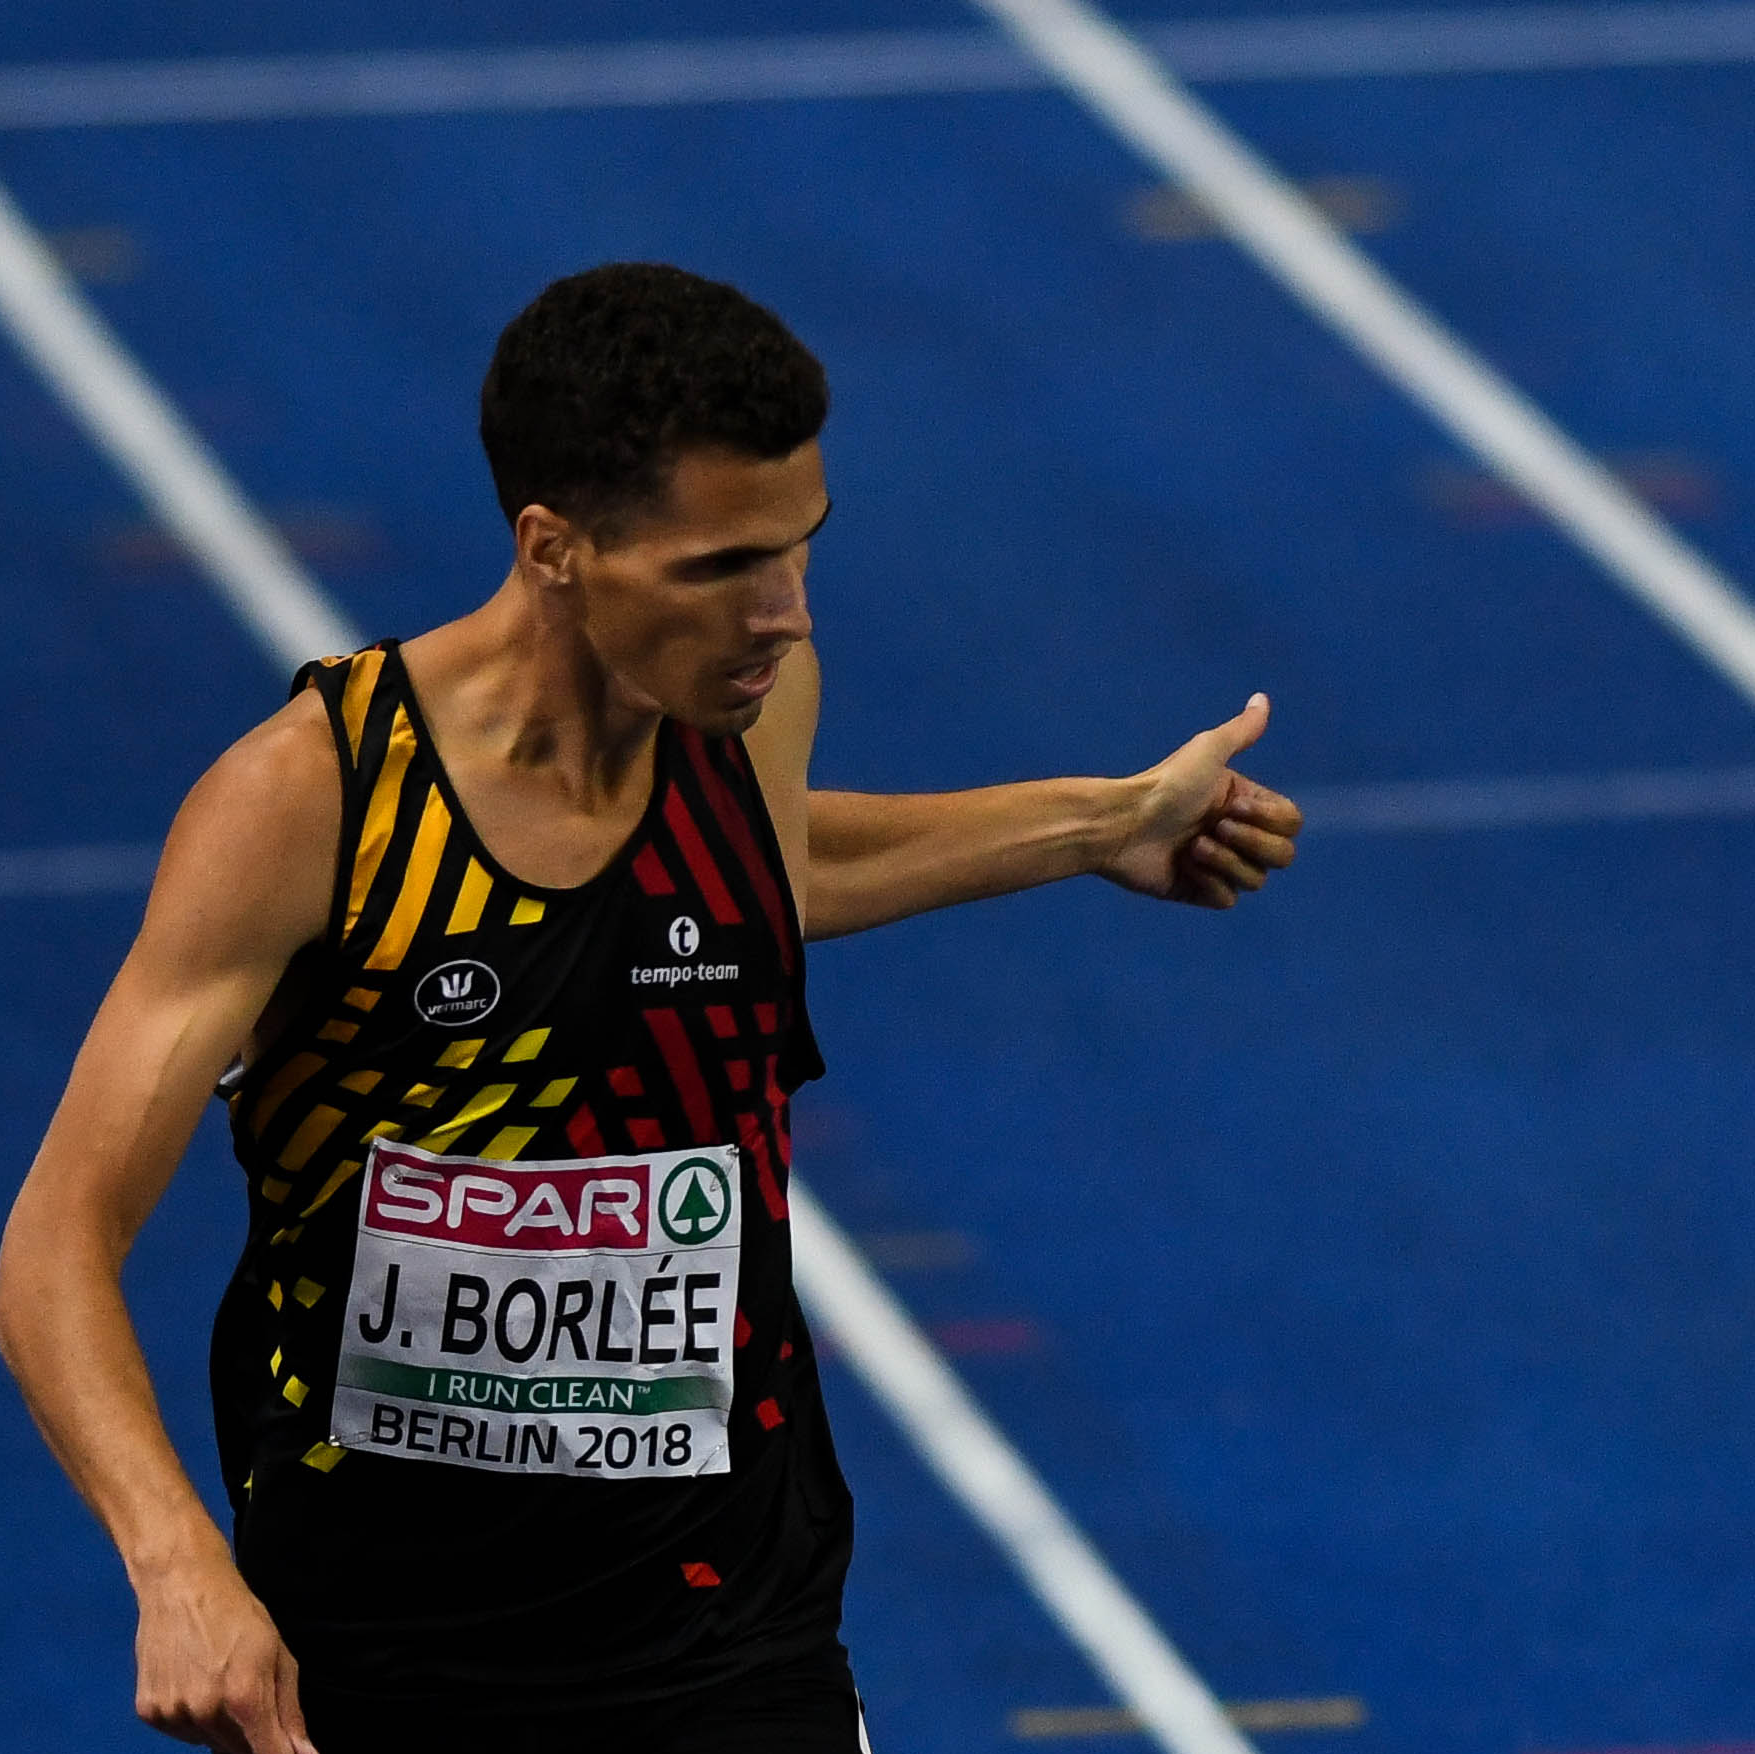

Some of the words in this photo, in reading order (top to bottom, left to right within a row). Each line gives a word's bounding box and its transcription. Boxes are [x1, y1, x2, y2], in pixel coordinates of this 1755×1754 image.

[630, 960, 739, 988] tempo-team
[427, 998, 487, 1016] vermarc
[375, 1165, 642, 1236] SPAR
[359, 1263, 413, 1349] J.
[439, 1255, 721, 1363] BORLÉE
[428, 1374, 437, 1397] I
[447, 1376, 520, 1406] RUN
[369, 1403, 559, 1465] BERLIN
[574, 1422, 693, 1470] 2018
